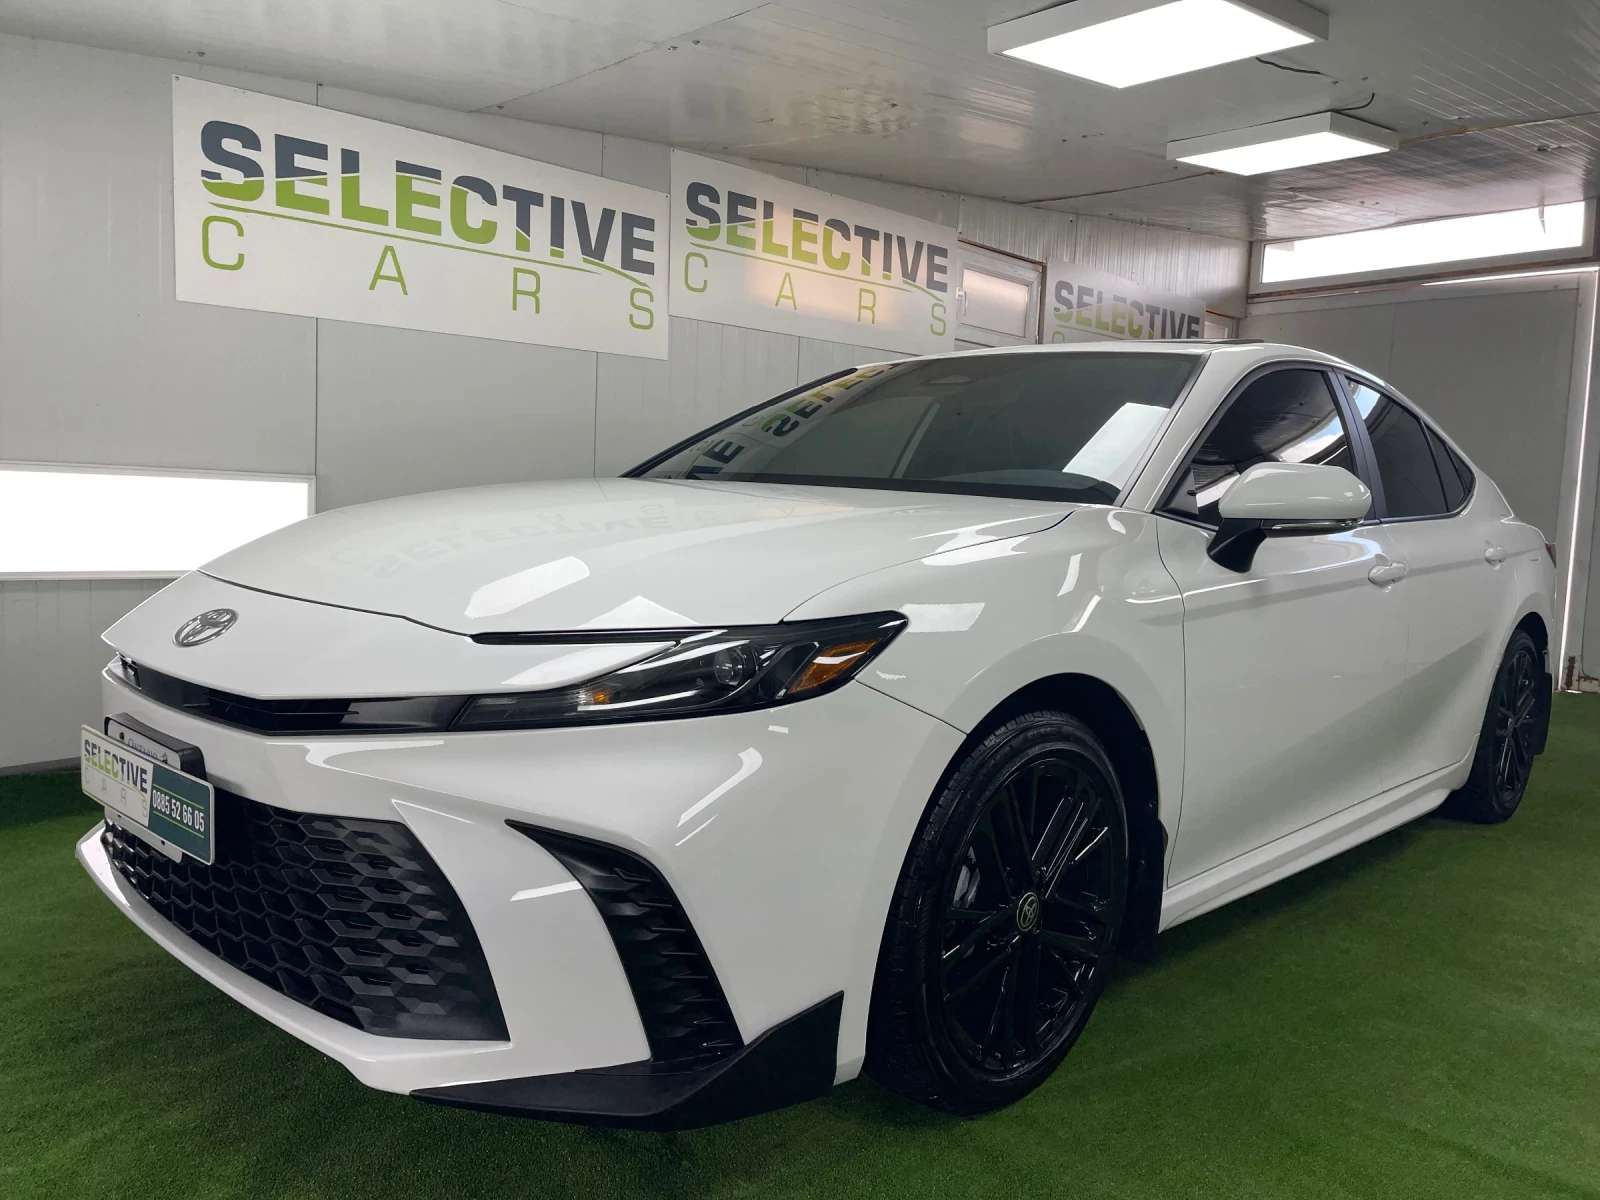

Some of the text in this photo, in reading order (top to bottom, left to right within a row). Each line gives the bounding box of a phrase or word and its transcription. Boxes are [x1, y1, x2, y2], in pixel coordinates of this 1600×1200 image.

[200, 120, 655, 276] SELECTIVE
[685, 181, 948, 293] SELECTIVE
[201, 215, 655, 331] CARS
[684, 252, 947, 337] CARS
[1053, 280, 1200, 340] SELECTIVE
[84, 739, 148, 795] SELECTIVE
[152, 789, 205, 833] 0885 52 66 05
